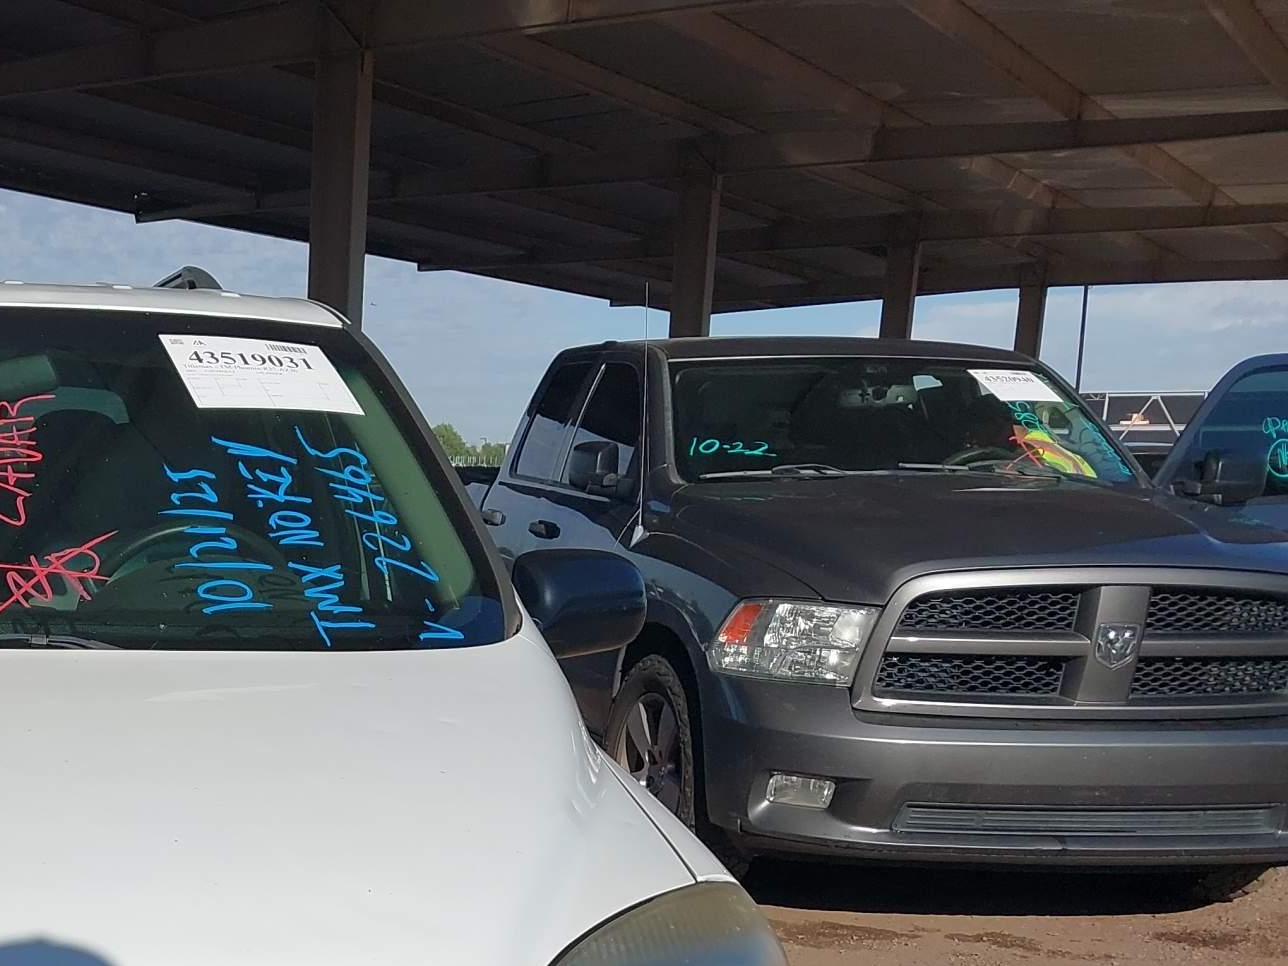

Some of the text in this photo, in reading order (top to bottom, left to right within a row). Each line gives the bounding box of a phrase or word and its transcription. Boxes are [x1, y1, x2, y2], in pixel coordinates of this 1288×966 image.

[188, 349, 314, 370] 43519031
[689, 437, 777, 456] 10-22
[158, 462, 274, 615] 10/21/25
[269, 511, 325, 547] NO
[288, 561, 376, 647] TMX
